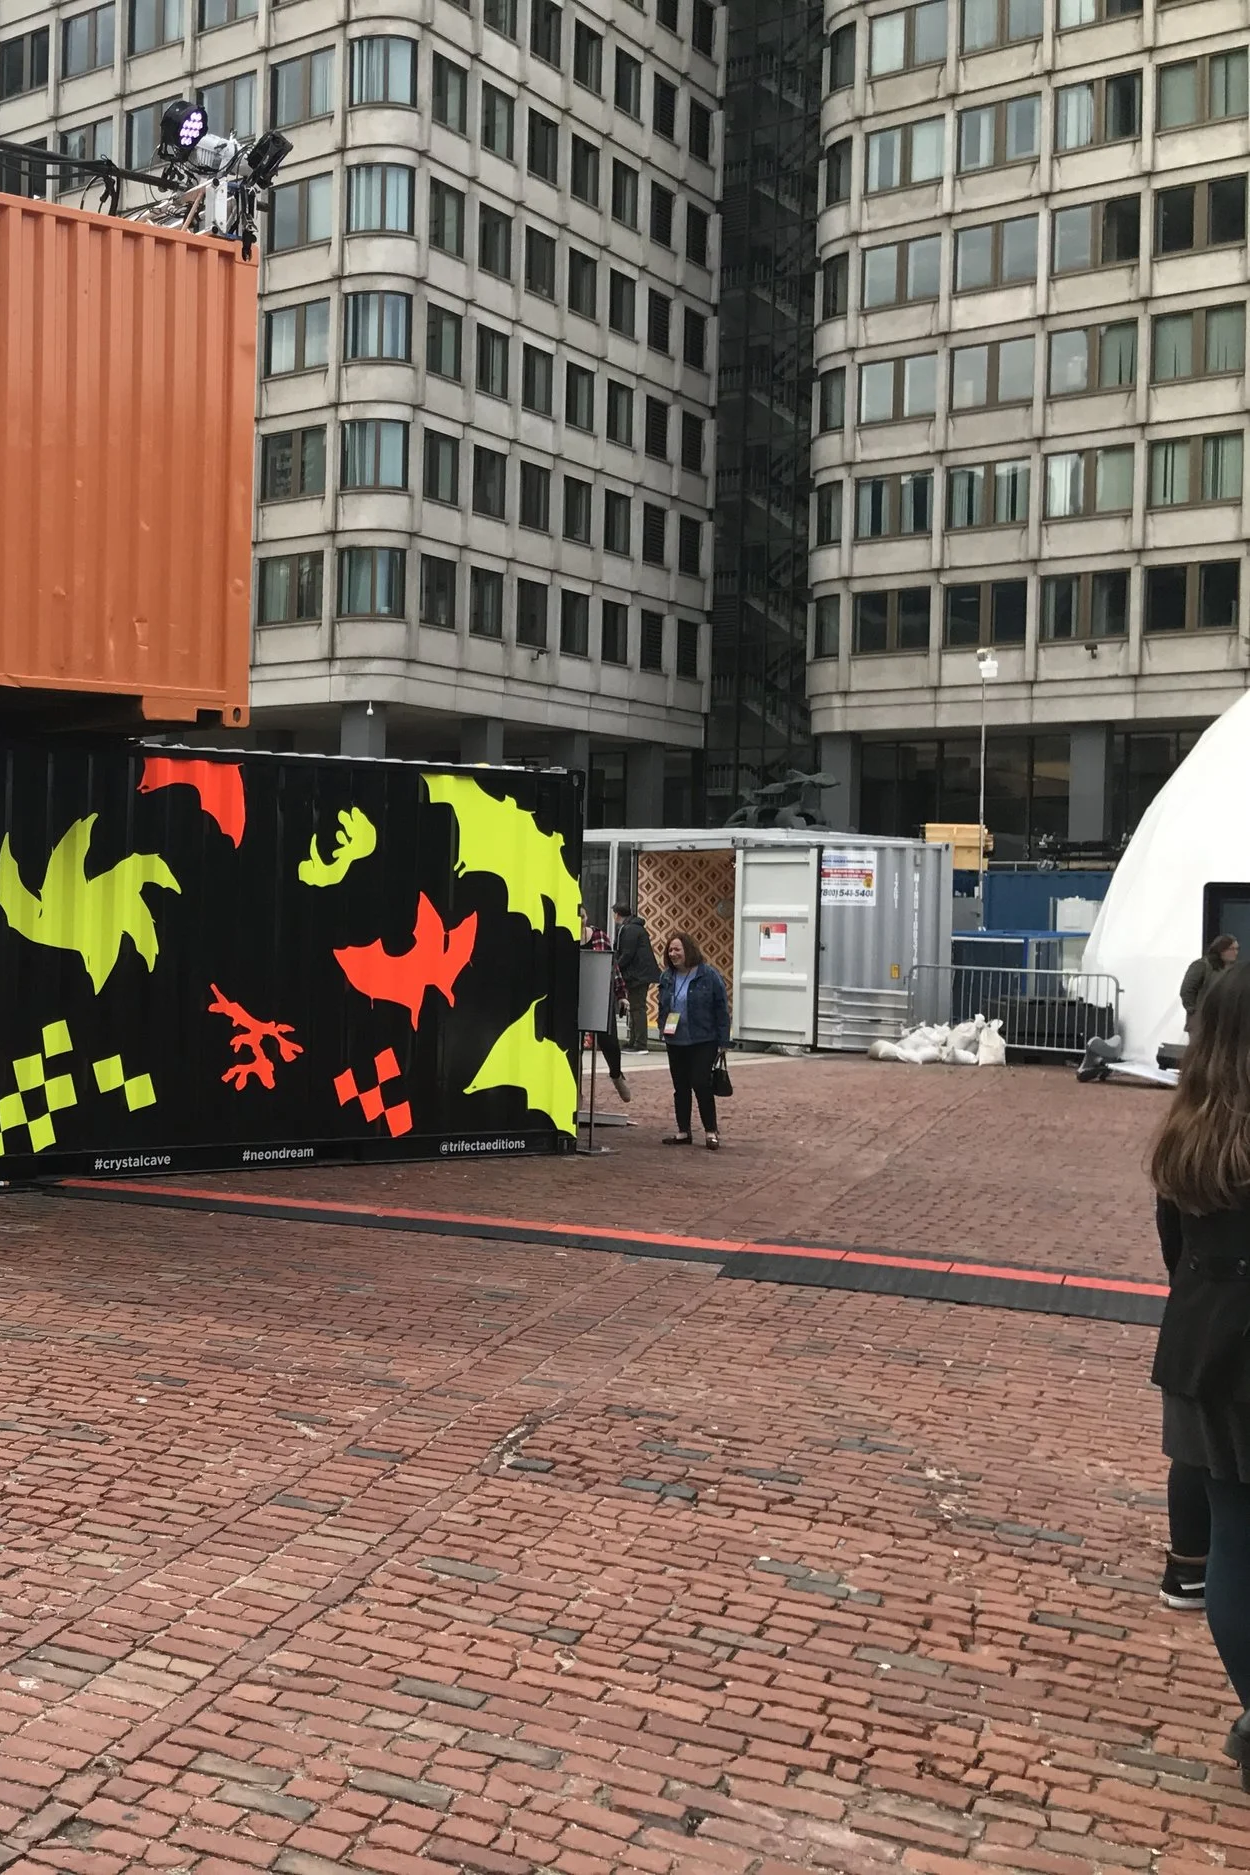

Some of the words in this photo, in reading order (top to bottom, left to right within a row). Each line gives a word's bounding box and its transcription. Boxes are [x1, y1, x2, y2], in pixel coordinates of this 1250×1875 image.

[242, 1147, 314, 1161] #neondream
[439, 1138, 526, 1155] @trifectaeditions
[94, 1154, 171, 1171] #crystalcave
